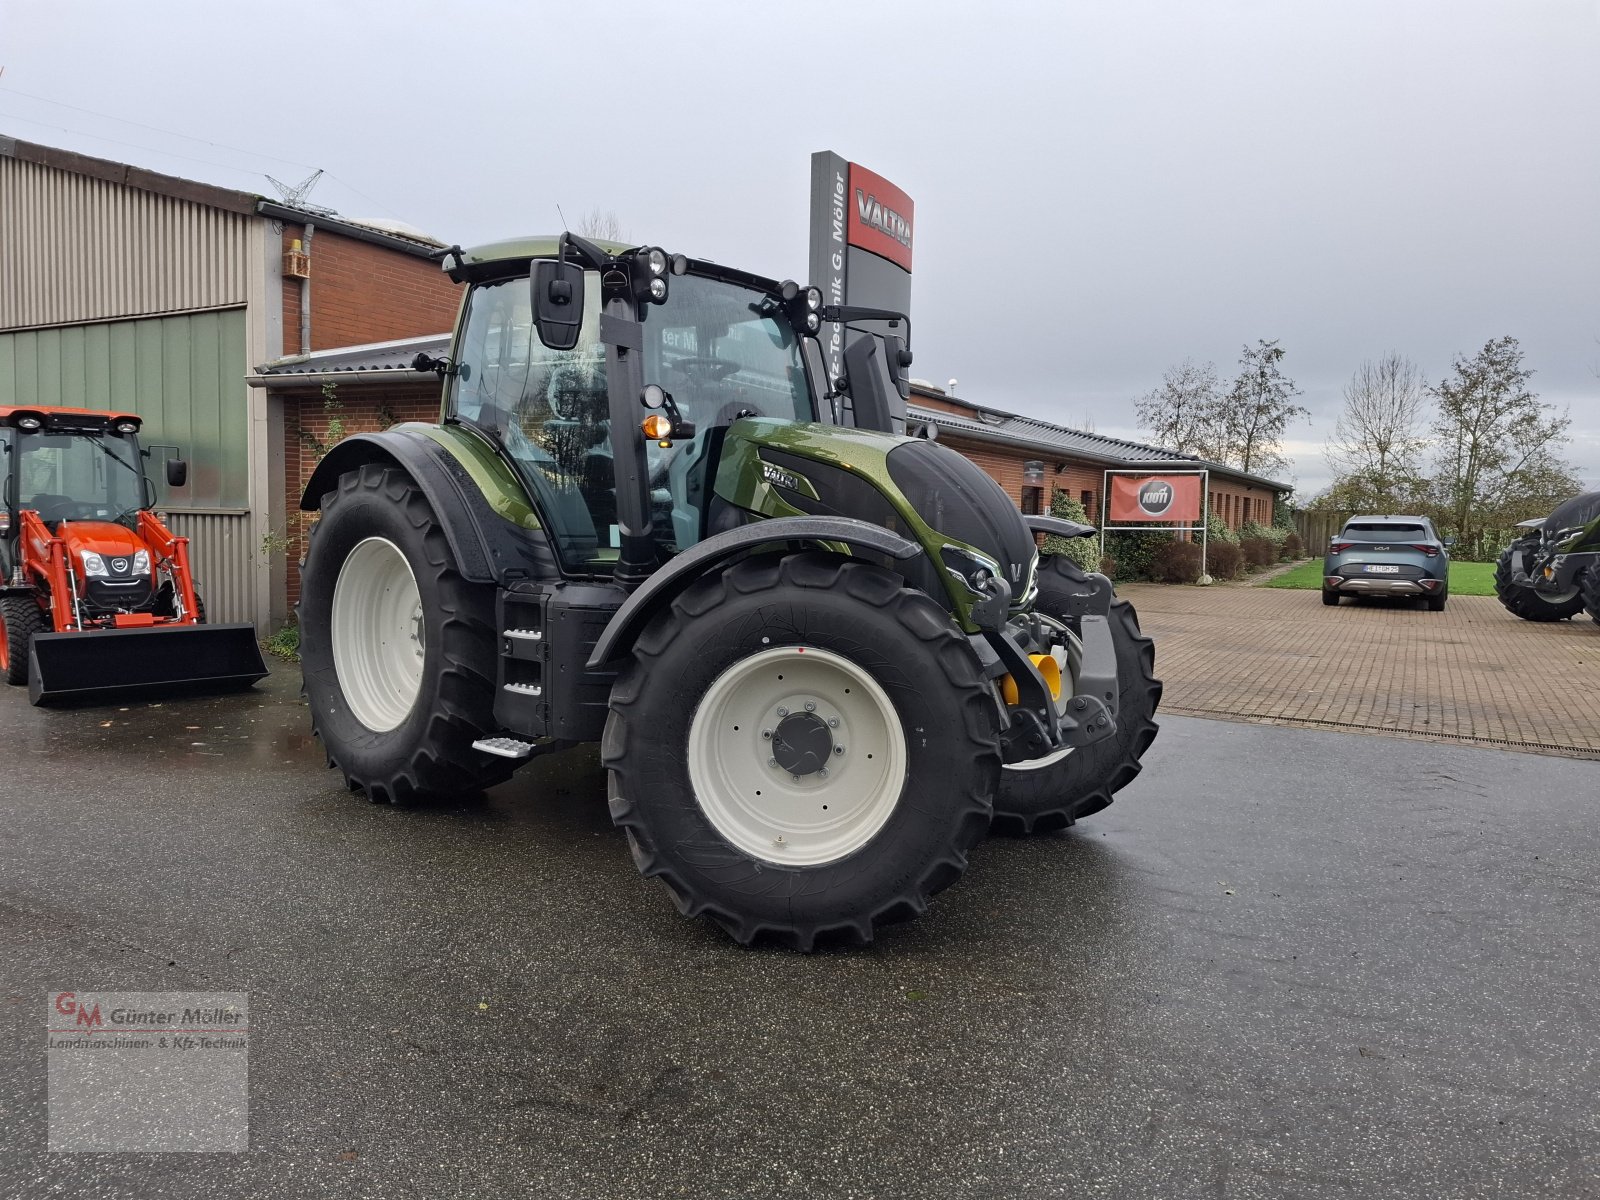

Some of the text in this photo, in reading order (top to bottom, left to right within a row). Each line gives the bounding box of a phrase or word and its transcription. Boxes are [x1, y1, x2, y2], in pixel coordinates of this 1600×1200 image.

[832, 172, 844, 242] Möller
[856, 188, 911, 249] VALTRA
[832, 249, 843, 271] G.
[1142, 490, 1168, 504] KIOTI
